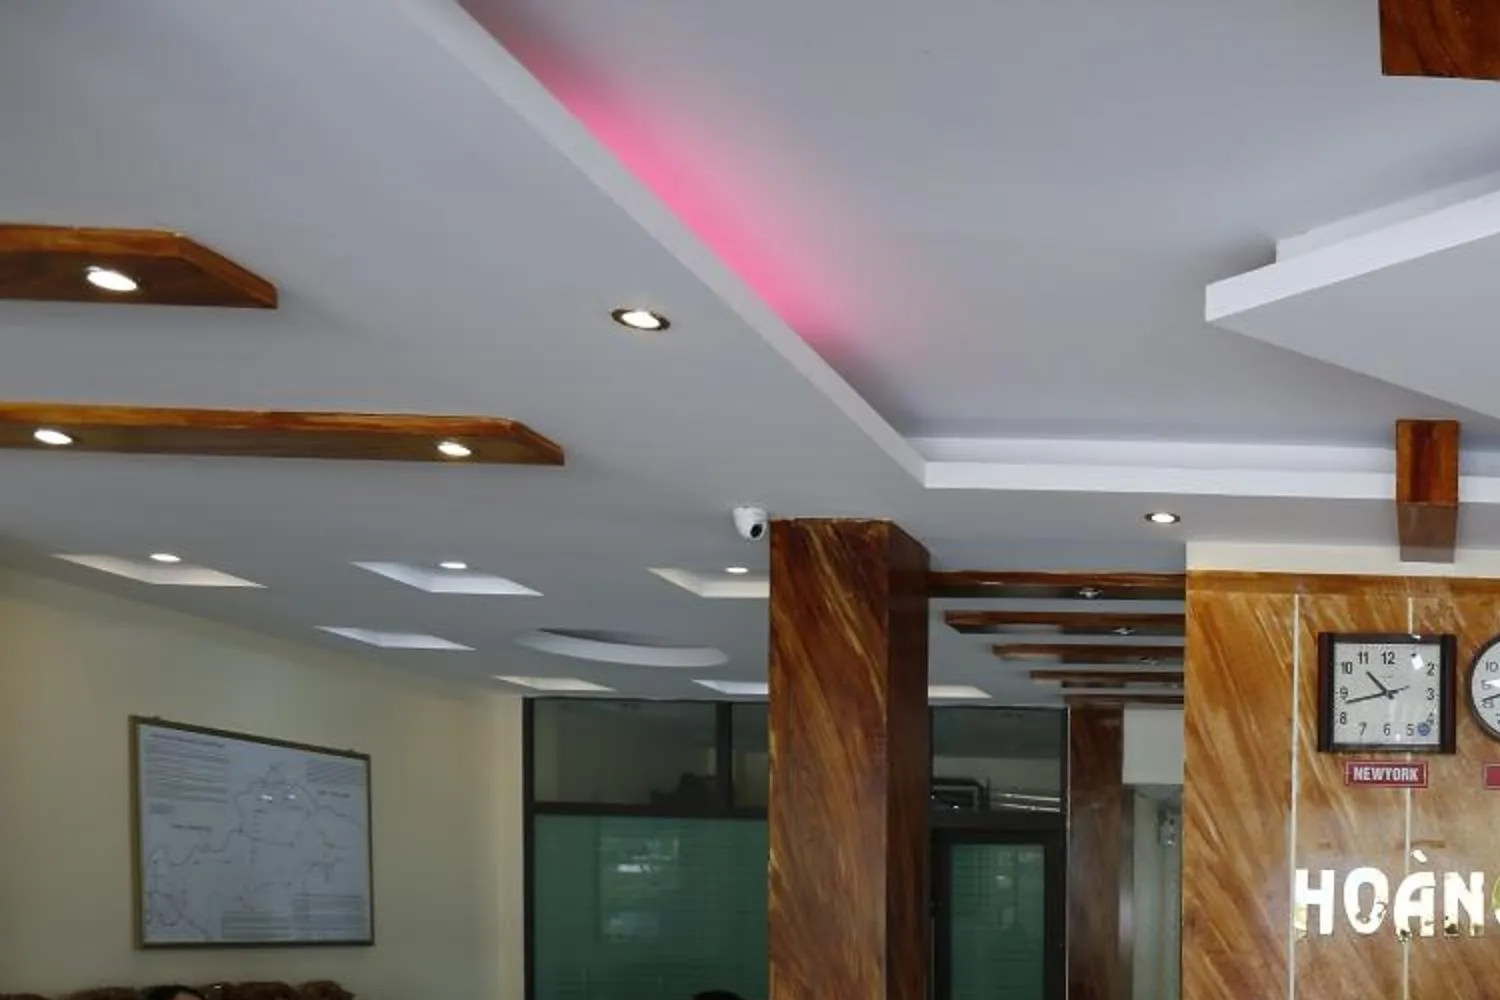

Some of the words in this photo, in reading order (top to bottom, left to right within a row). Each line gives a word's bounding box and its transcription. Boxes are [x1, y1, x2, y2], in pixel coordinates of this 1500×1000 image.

[1357, 652, 1369, 664] 11
[1381, 652, 1395, 664] 12
[1340, 662, 1353, 674] 10
[1426, 662, 1435, 677] 2
[1486, 661, 1499, 673] 10
[1339, 686, 1348, 699] 9
[1426, 688, 1435, 701] 3
[1339, 712, 1347, 724] 8
[1359, 722, 1367, 736] 7
[1383, 724, 1391, 736] 6
[1407, 723, 1414, 736] 5
[1353, 766, 1418, 781] NEWYORK
